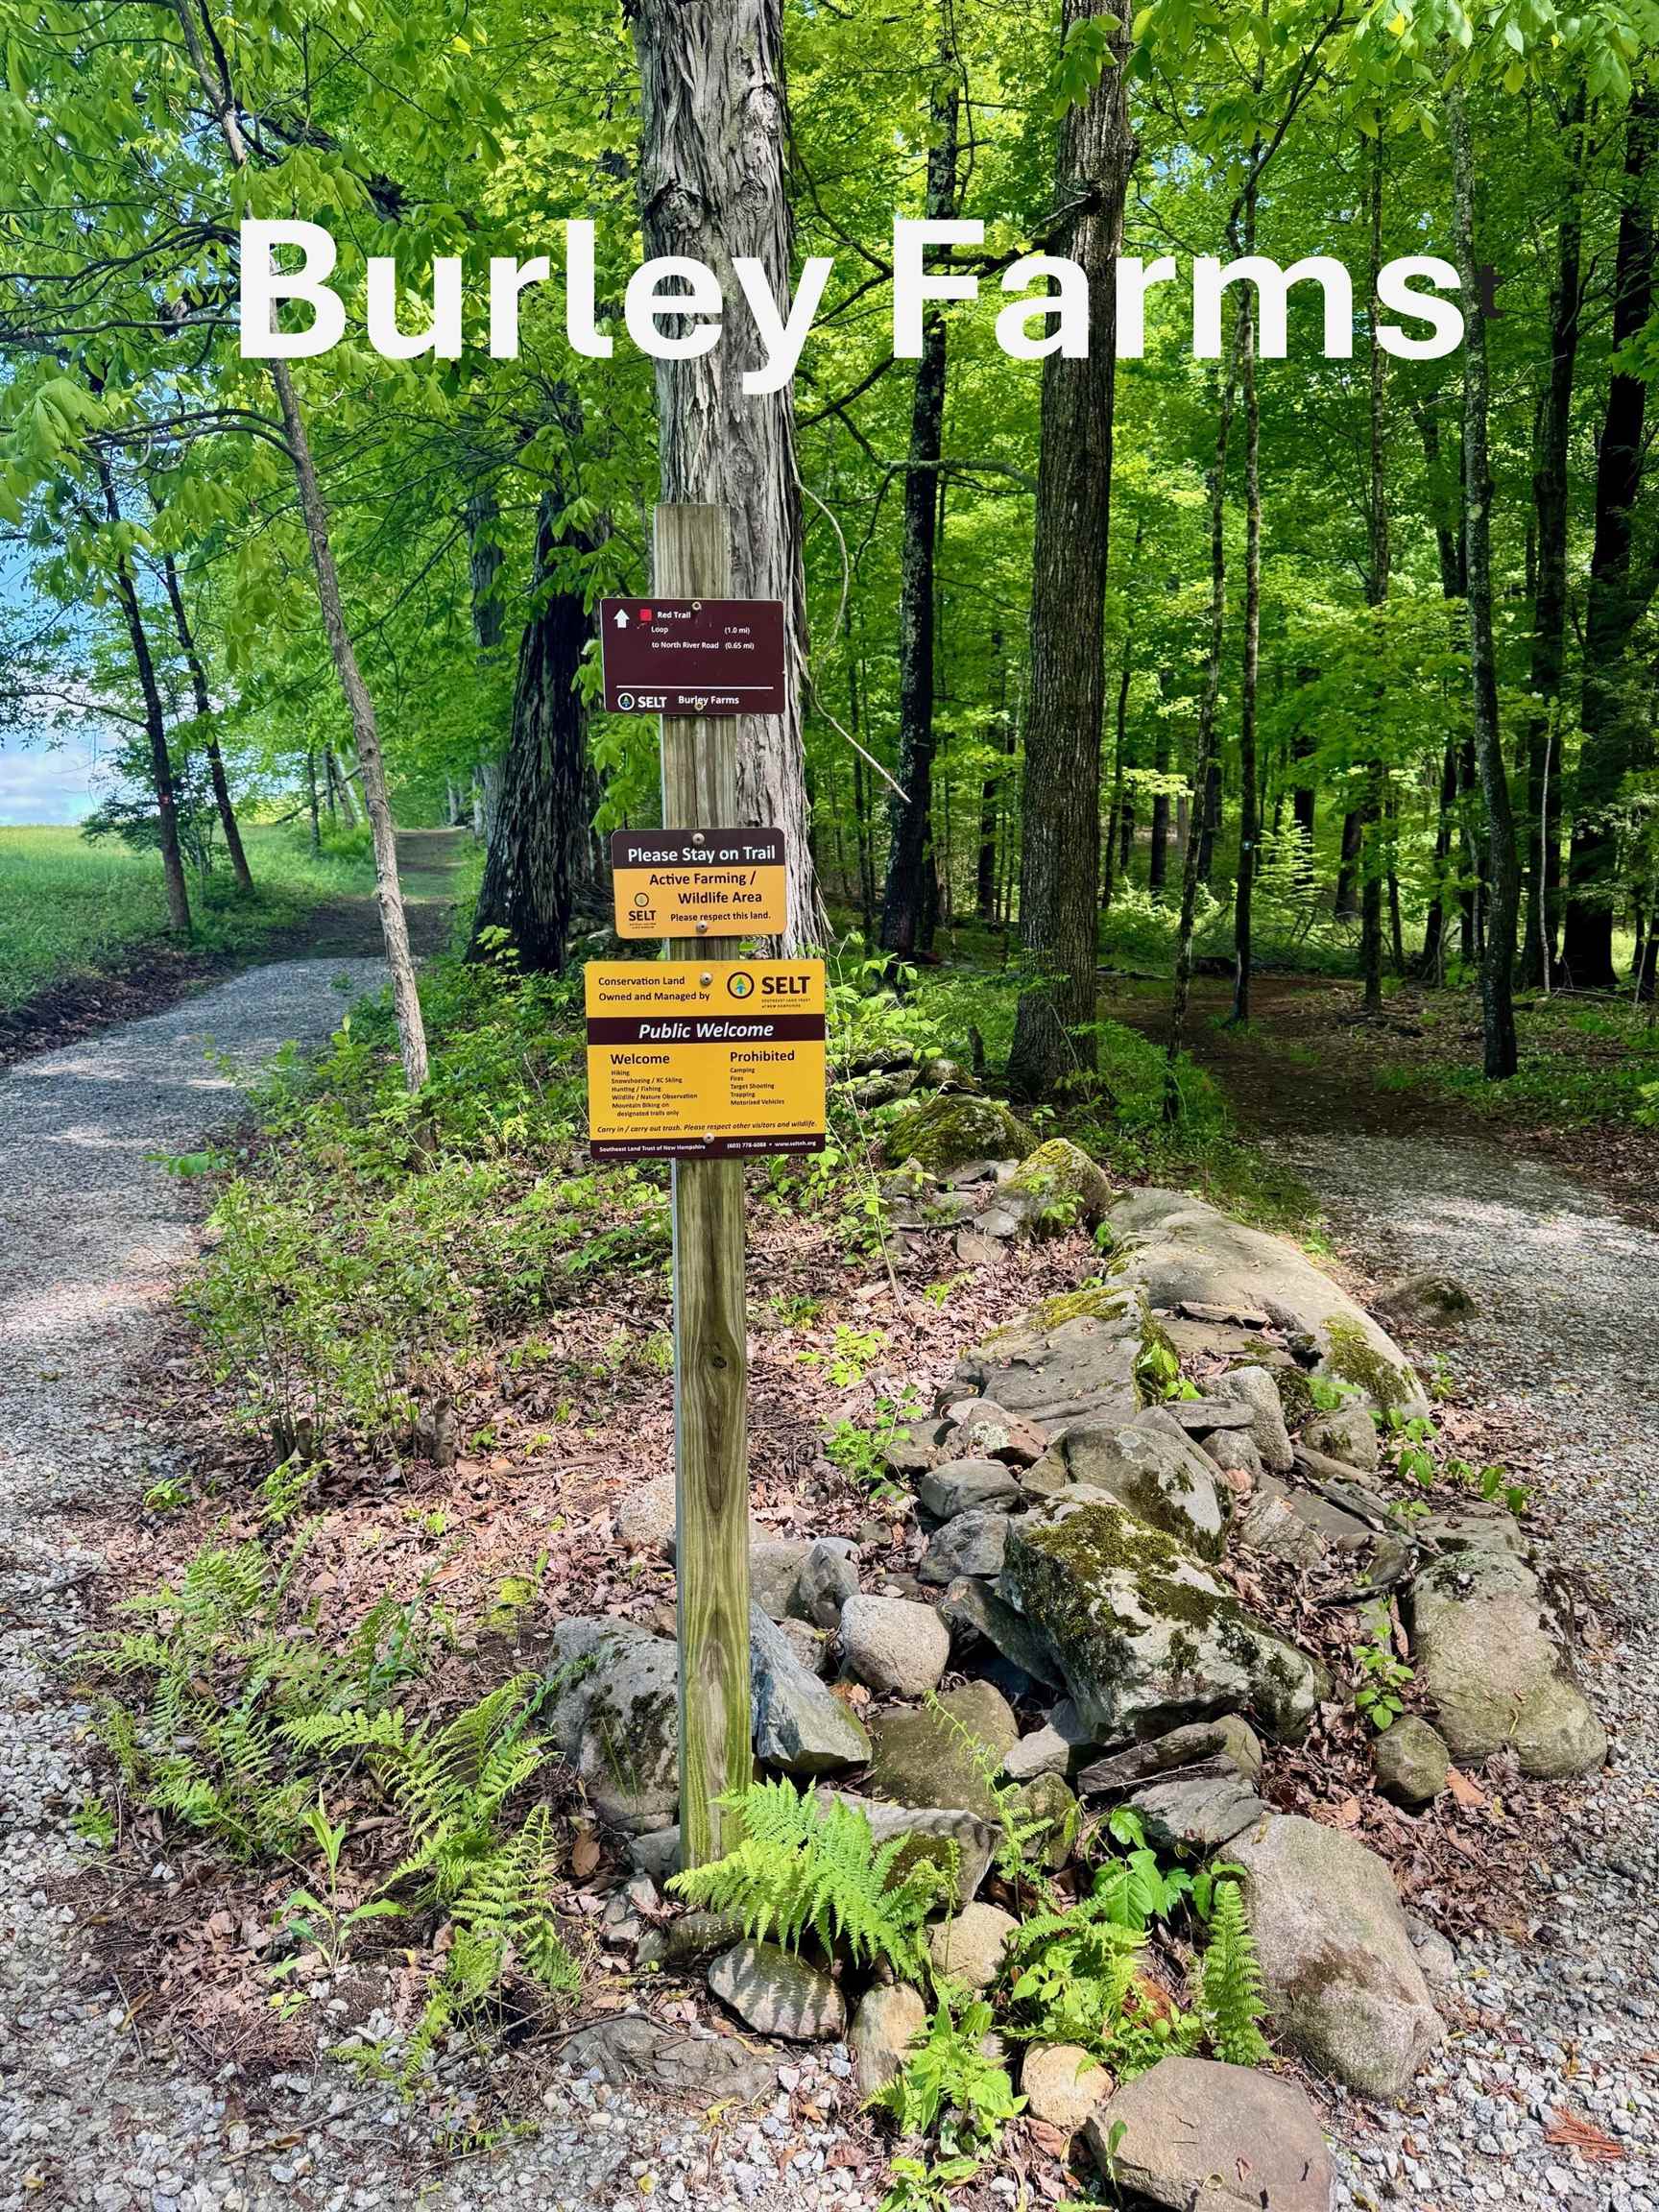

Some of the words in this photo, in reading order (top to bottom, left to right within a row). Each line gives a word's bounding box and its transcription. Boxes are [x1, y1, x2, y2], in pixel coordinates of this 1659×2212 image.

[638, 696, 667, 708] SELT
[678, 696, 708, 707] Burley
[711, 696, 739, 704] Farms
[628, 847, 678, 862] Please
[682, 847, 714, 863] Stay
[720, 849, 739, 860] on
[743, 845, 775, 860] Trail
[650, 873, 690, 885] Active
[694, 872, 746, 886] Farming
[750, 871, 757, 885] /
[678, 892, 728, 904] Wildlife
[732, 892, 762, 903] Area
[629, 910, 656, 921] SELT
[671, 913, 697, 921] Please
[700, 914, 731, 922] respect
[733, 912, 748, 920] this
[750, 911, 771, 920] land.
[599, 977, 660, 986] Conservation
[663, 976, 685, 985] Land
[762, 976, 811, 994] SELT
[599, 992, 631, 1001] Owned
[634, 992, 651, 1000] and
[654, 992, 696, 1001] Managed
[699, 991, 710, 1001] by
[638, 1022, 691, 1038] Public
[697, 1022, 774, 1037] Welcome
[610, 1053, 670, 1064] Welcome
[730, 1049, 795, 1062] Prohibited
